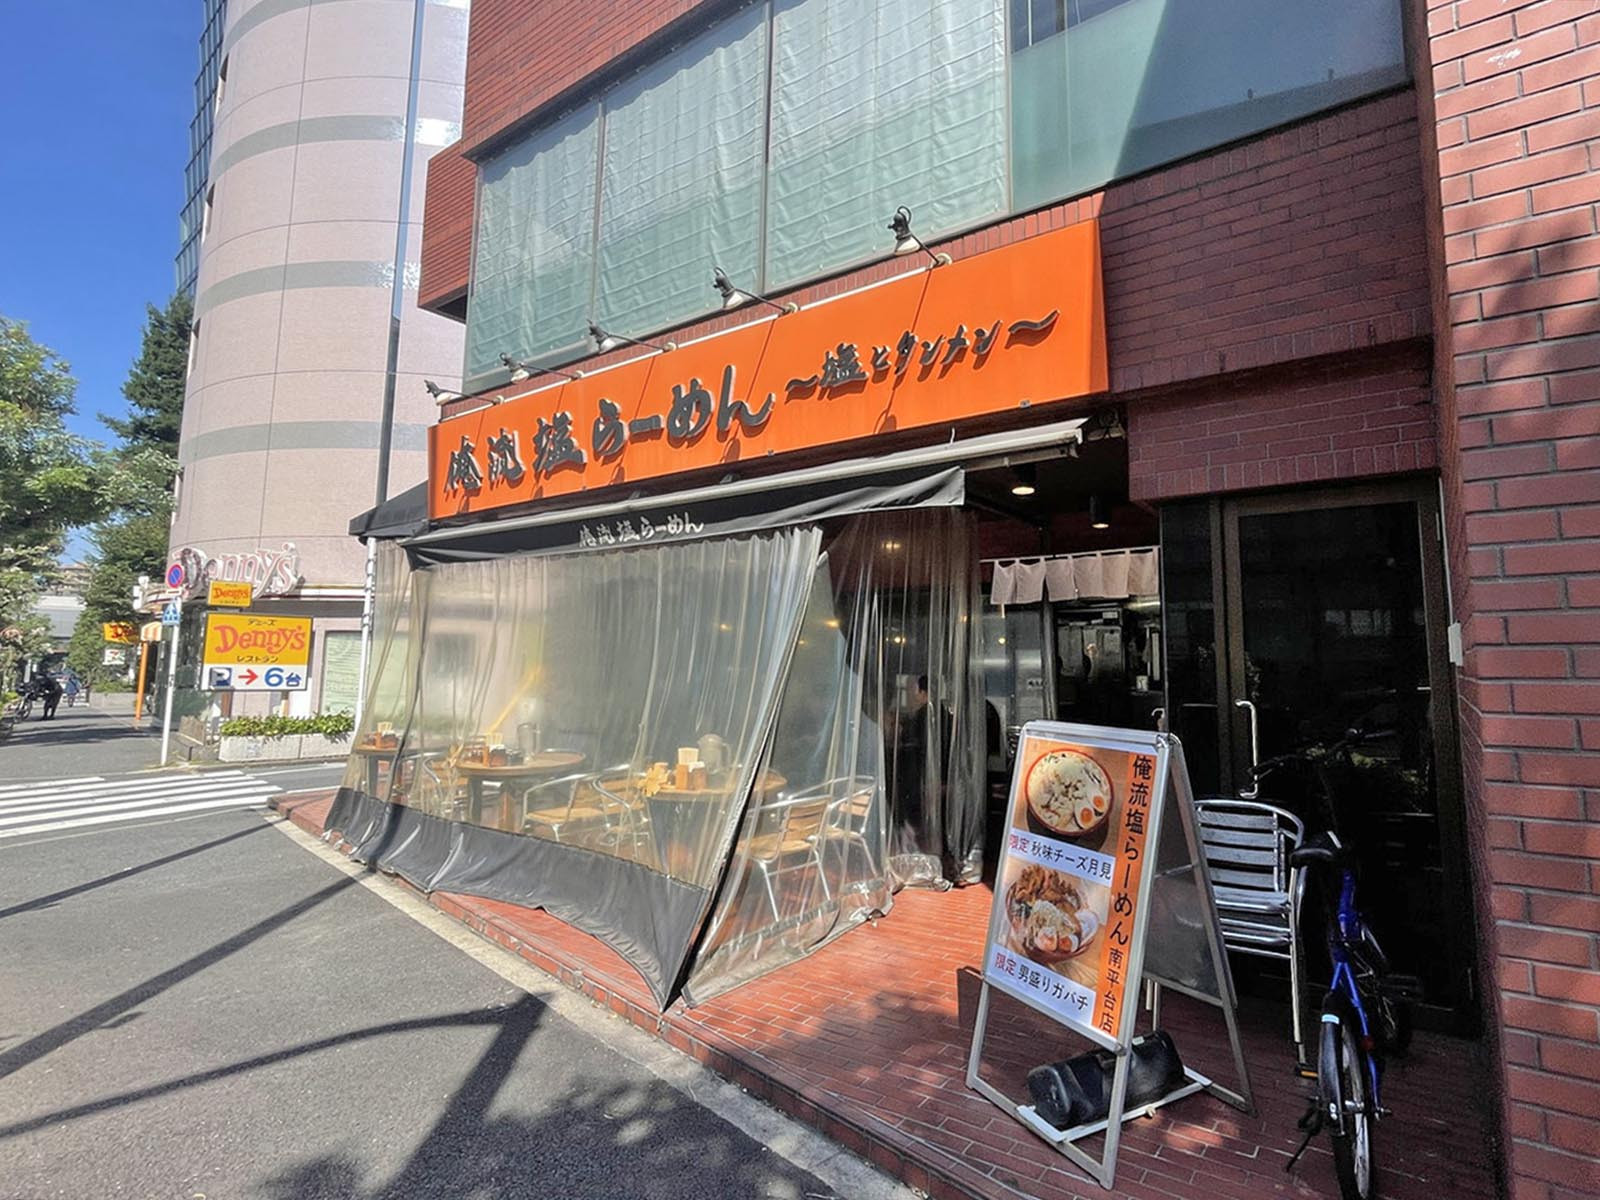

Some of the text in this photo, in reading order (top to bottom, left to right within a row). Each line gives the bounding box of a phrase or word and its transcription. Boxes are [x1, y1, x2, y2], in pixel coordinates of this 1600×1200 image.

[444, 364, 775, 494] 俺流塩らーめん
[579, 512, 704, 548] 俺流塩らーめん
[213, 624, 306, 655] Denny's
[236, 655, 279, 663] レストラン
[264, 667, 302, 687] 6台
[1009, 833, 1113, 880] 限定 秋味チーズ月見
[1099, 755, 1153, 1034] 俺流塩らーめん 南平台店
[994, 952, 1017, 977] 限定
